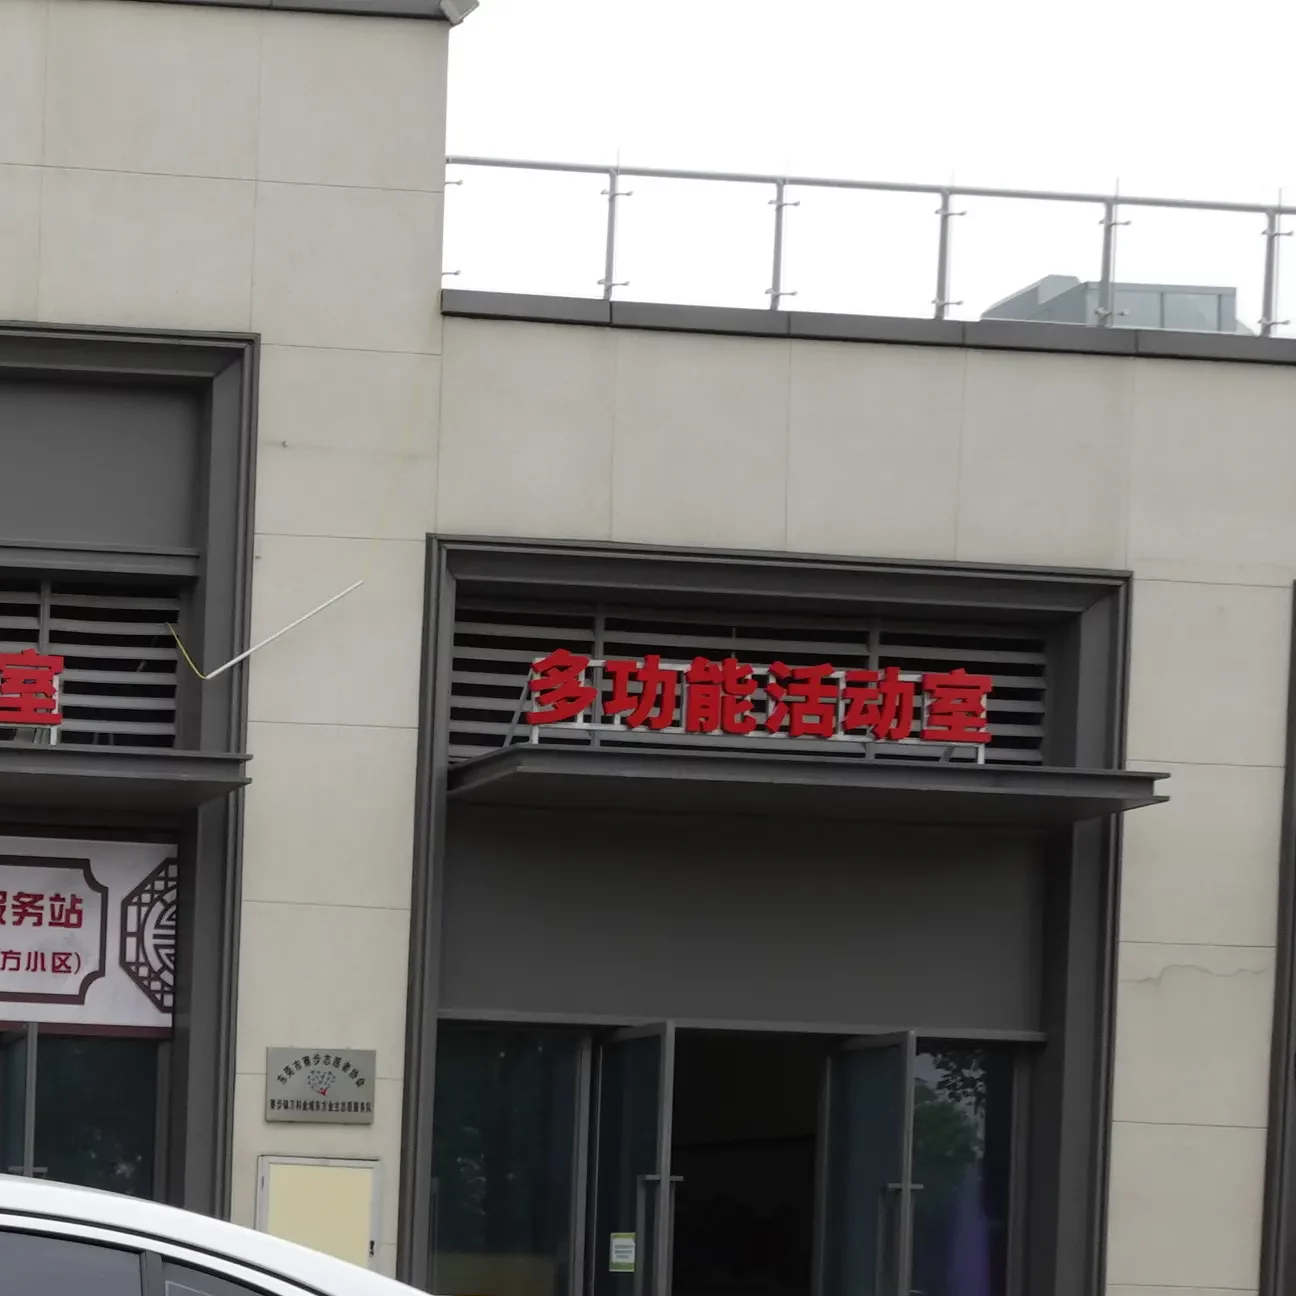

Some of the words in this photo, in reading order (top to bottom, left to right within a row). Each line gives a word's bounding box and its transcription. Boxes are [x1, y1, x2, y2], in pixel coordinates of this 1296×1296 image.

[526, 648, 993, 743] 多功能活动室
